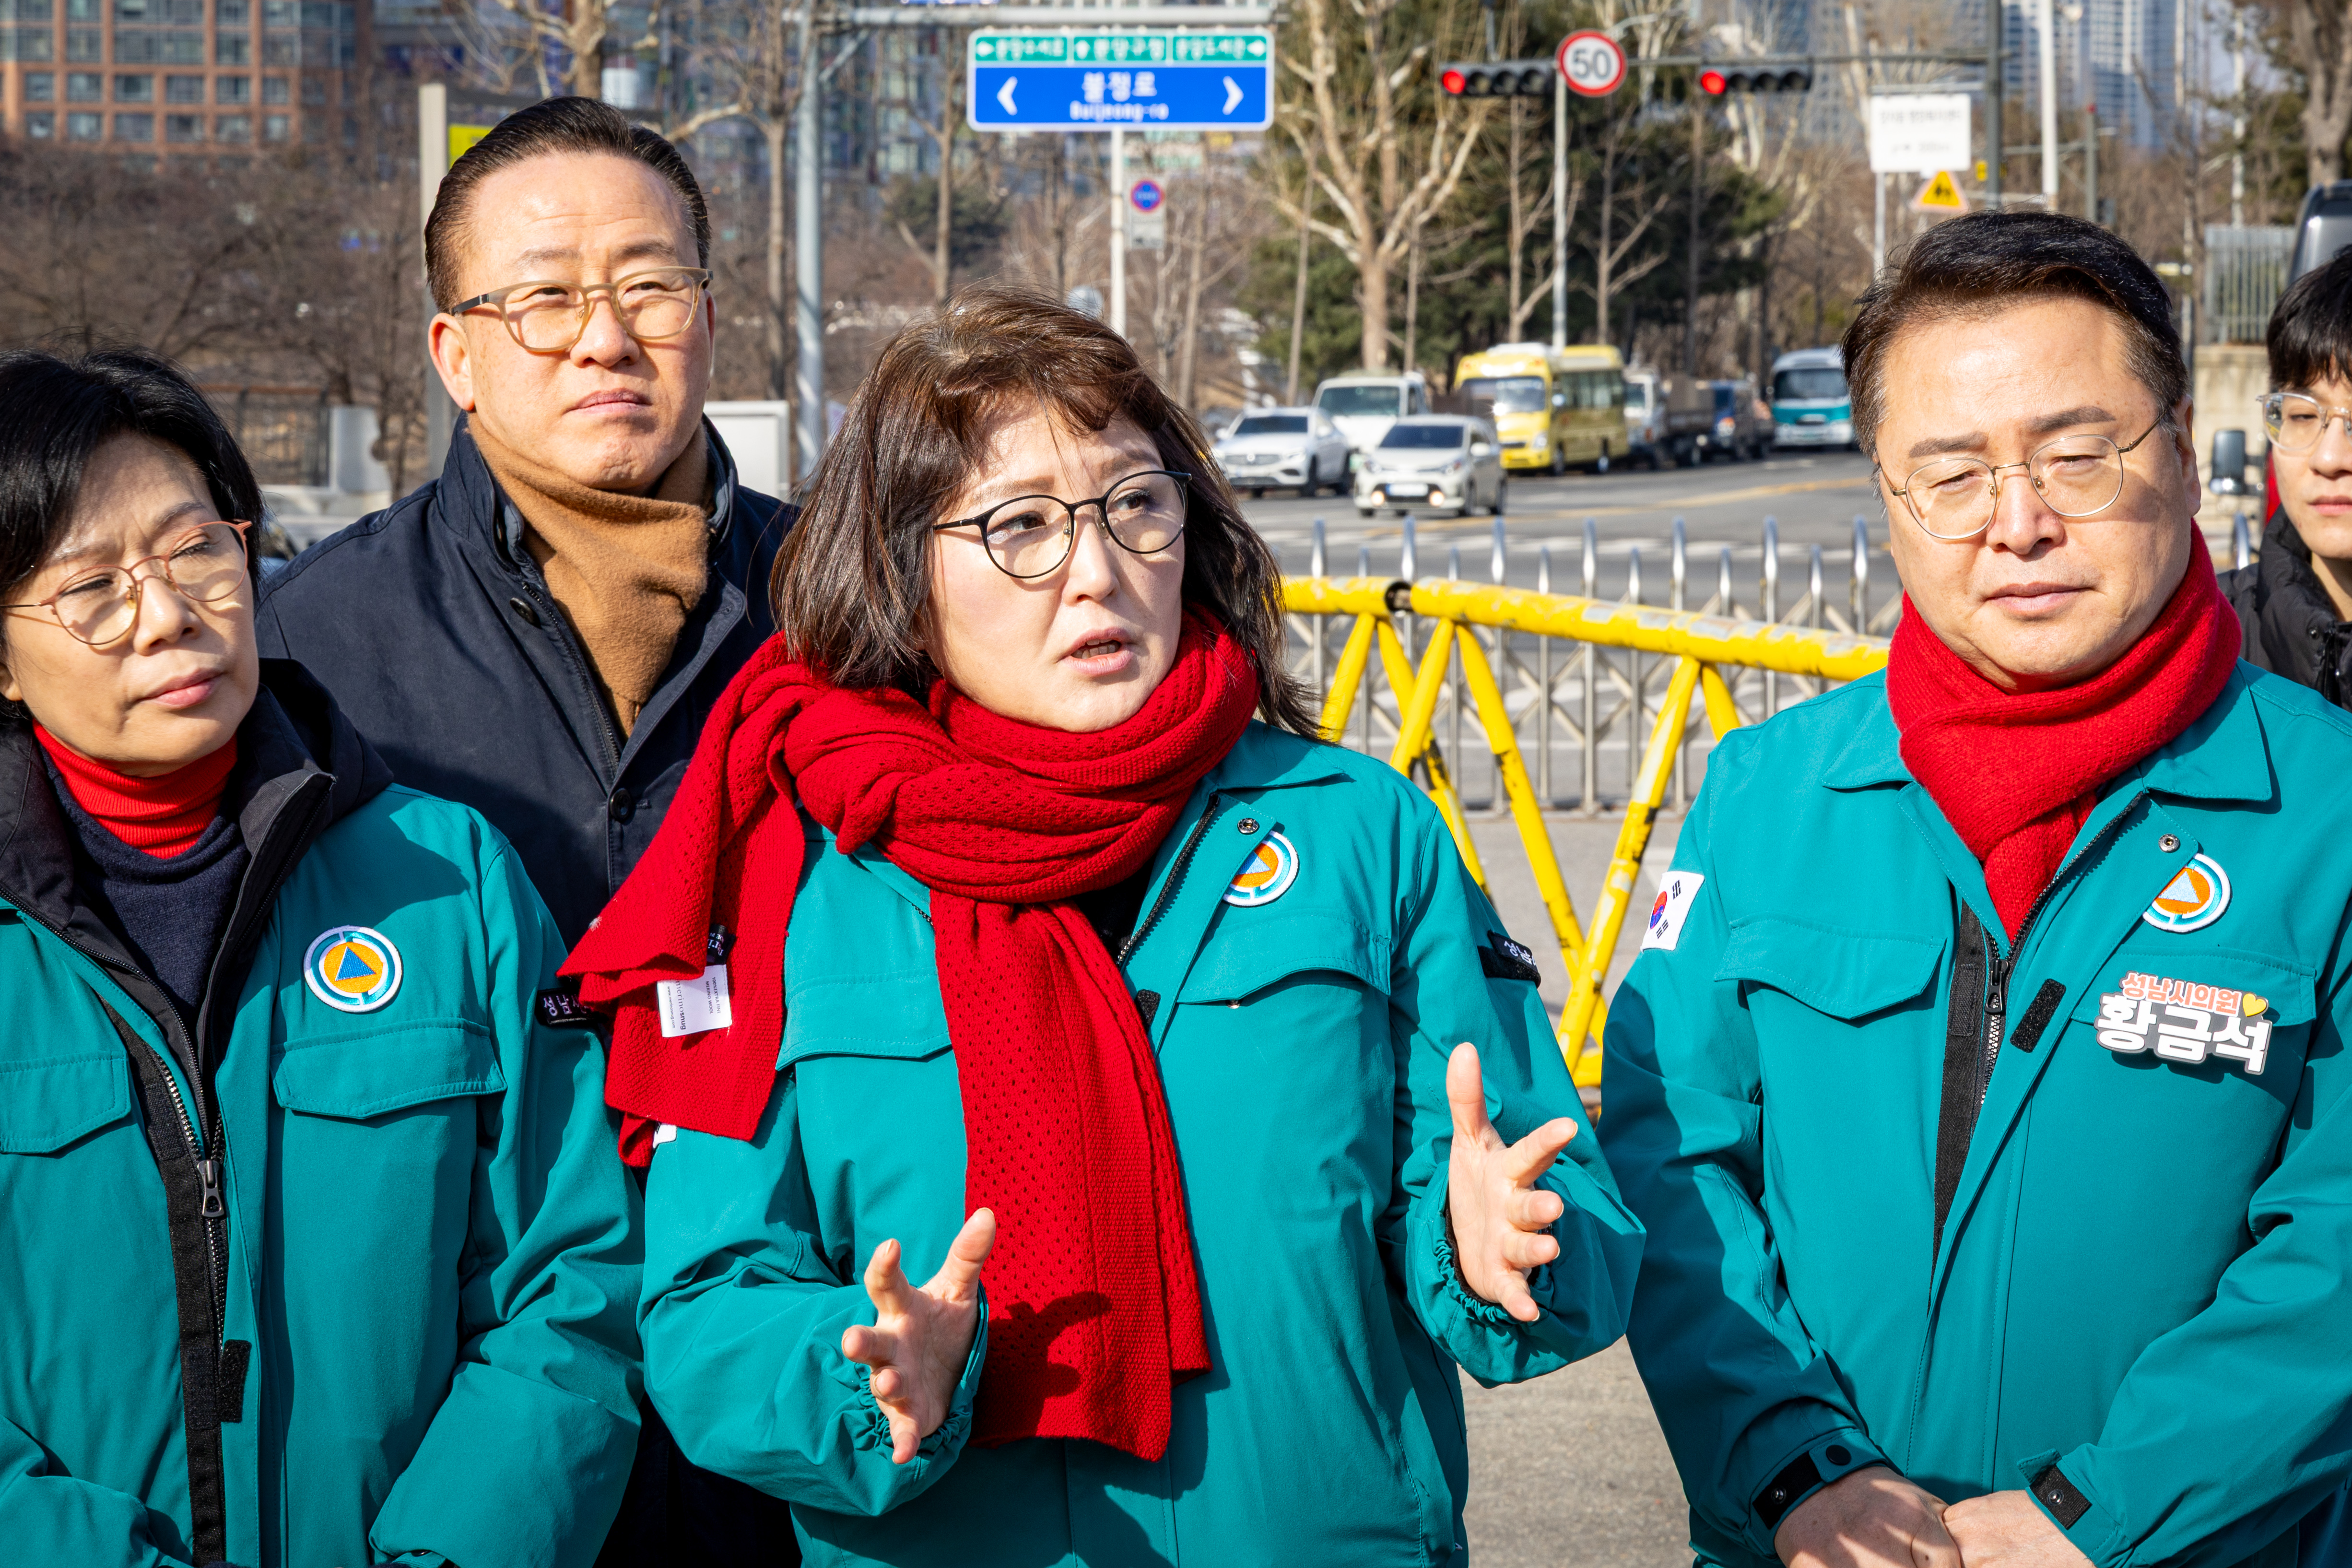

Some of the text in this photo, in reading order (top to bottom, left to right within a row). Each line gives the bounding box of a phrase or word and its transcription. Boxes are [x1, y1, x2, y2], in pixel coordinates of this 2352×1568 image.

[1573, 48, 1612, 80] 50
[1082, 71, 1157, 102] 불정로
[1070, 100, 1169, 122] Buljeong-ro
[1504, 941, 1536, 966] 성남
[675, 980, 686, 1030] merinosnug
[2123, 973, 2240, 1015] 성남시의원
[2097, 995, 2270, 1073] 황금석
